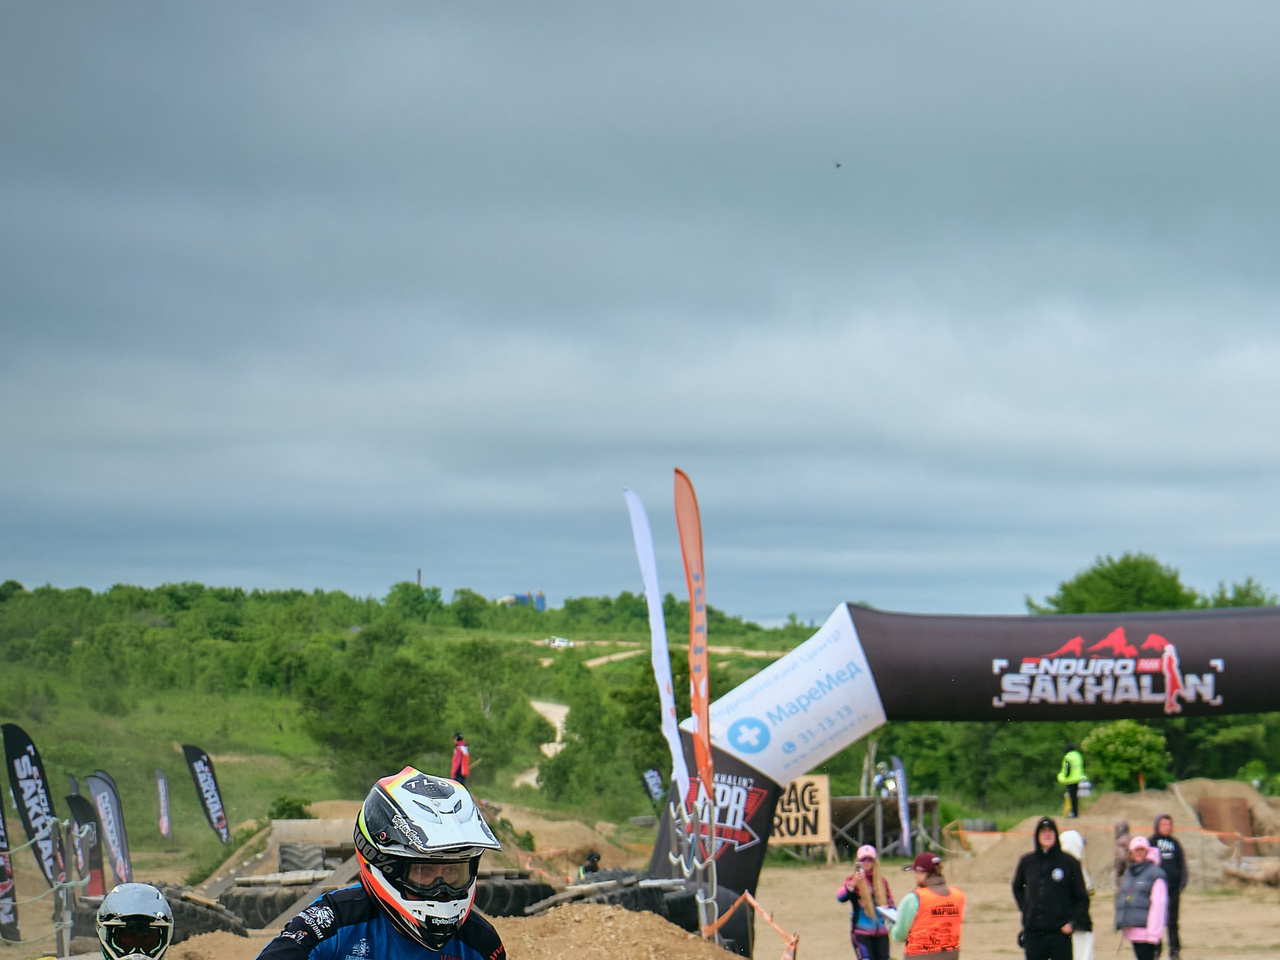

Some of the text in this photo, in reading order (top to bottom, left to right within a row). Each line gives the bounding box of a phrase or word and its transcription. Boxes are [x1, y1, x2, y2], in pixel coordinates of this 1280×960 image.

[1019, 657, 1135, 675] ENDURO
[766, 660, 864, 726] МареМед
[799, 705, 854, 745] 31-13-13
[407, 779, 449, 789] TLD
[771, 810, 820, 838] RUN
[354, 828, 398, 875] 100%
